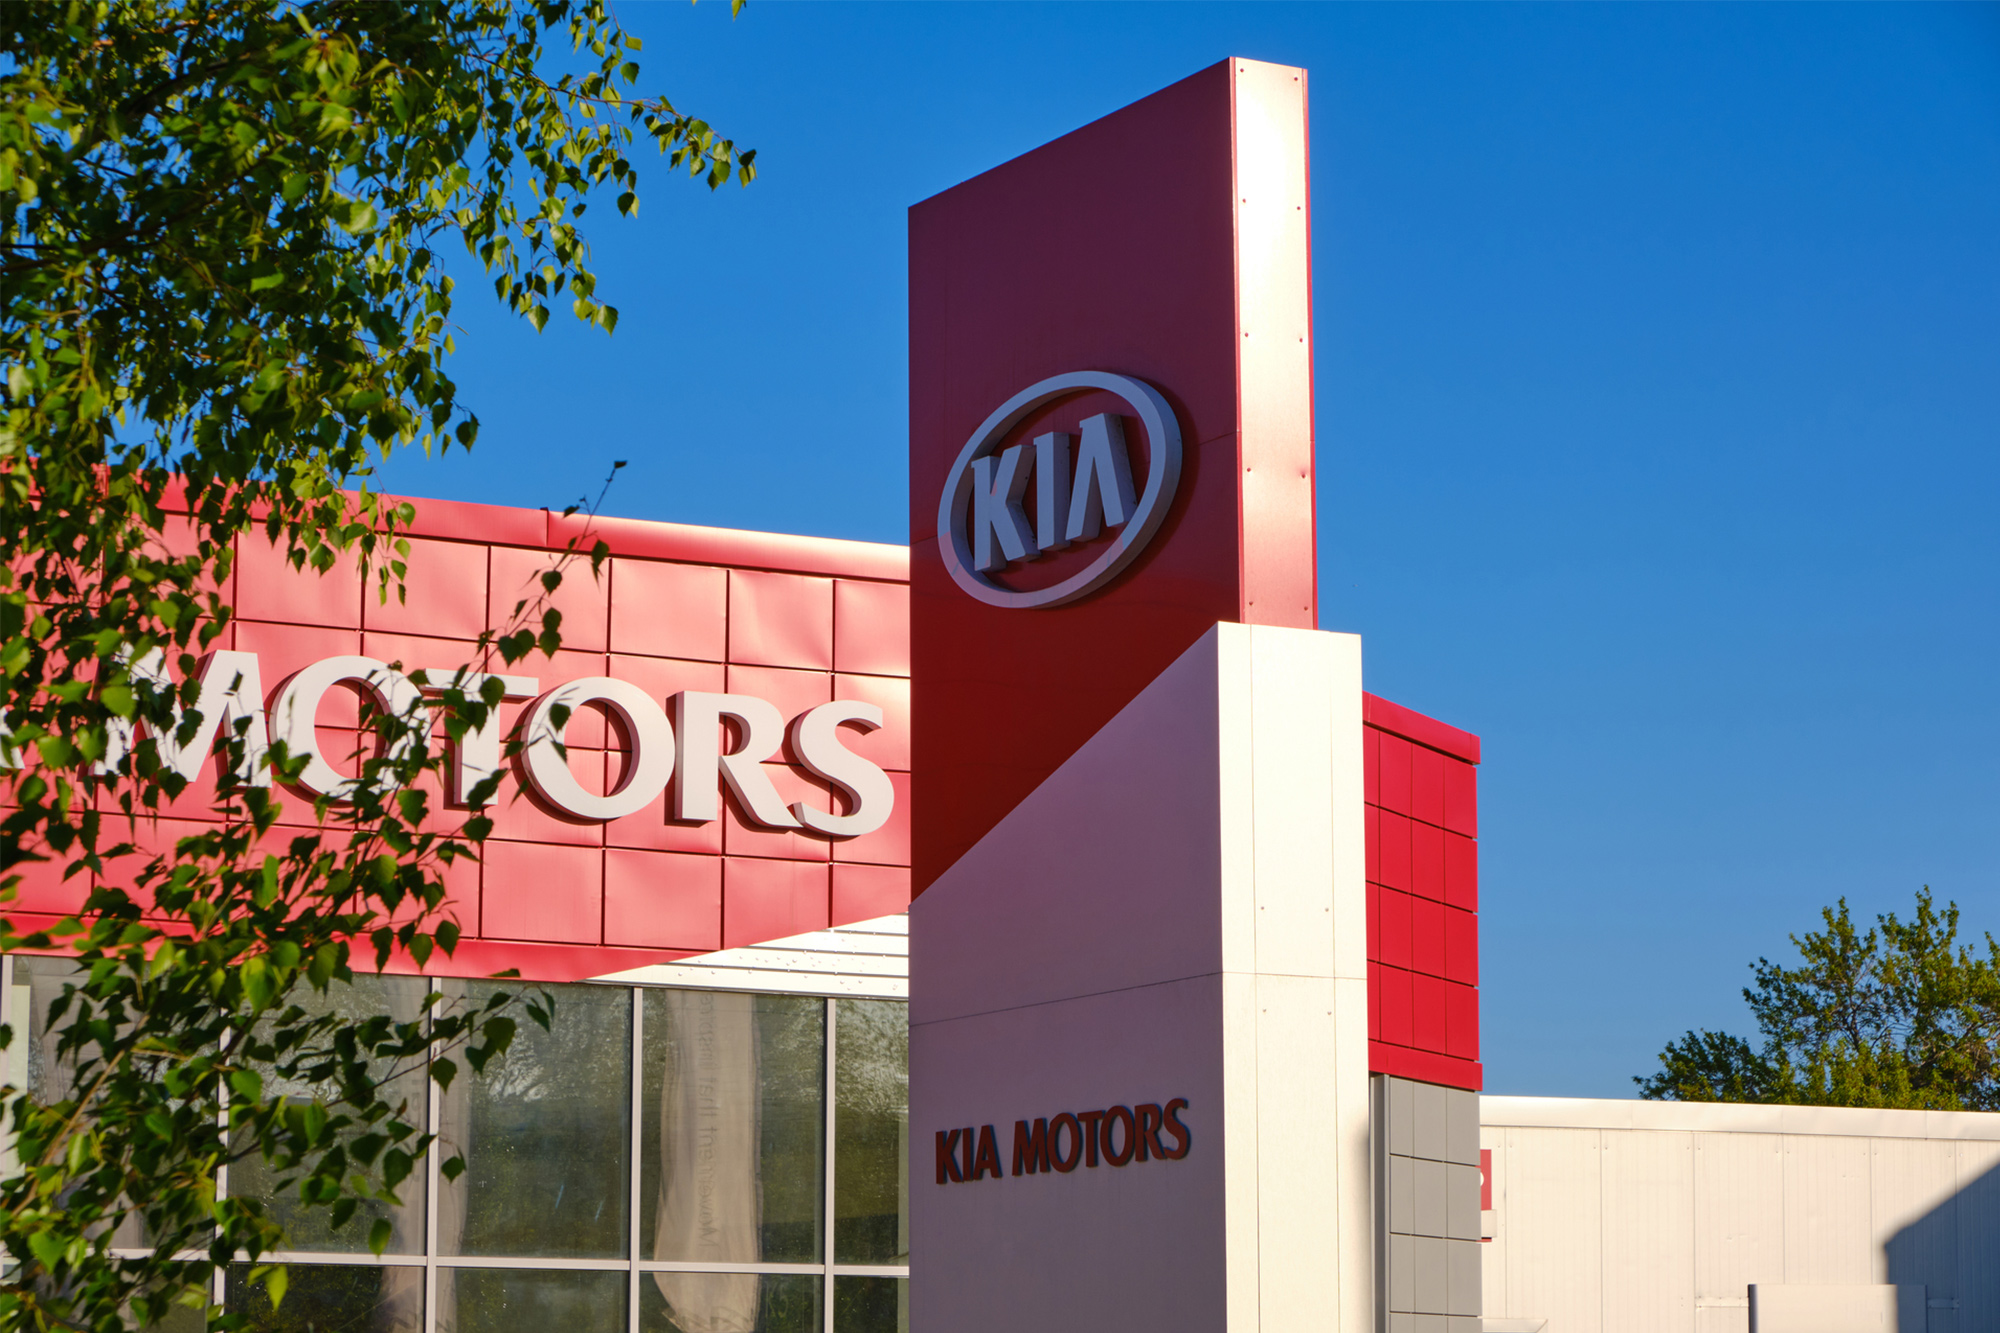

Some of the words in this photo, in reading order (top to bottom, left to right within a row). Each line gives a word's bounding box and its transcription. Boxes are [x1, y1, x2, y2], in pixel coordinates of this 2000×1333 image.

[971, 412, 1137, 571] KIA
[84, 641, 895, 837] MOTORS
[935, 1124, 1003, 1185] KIA
[1012, 1097, 1191, 1176] MOTORS
